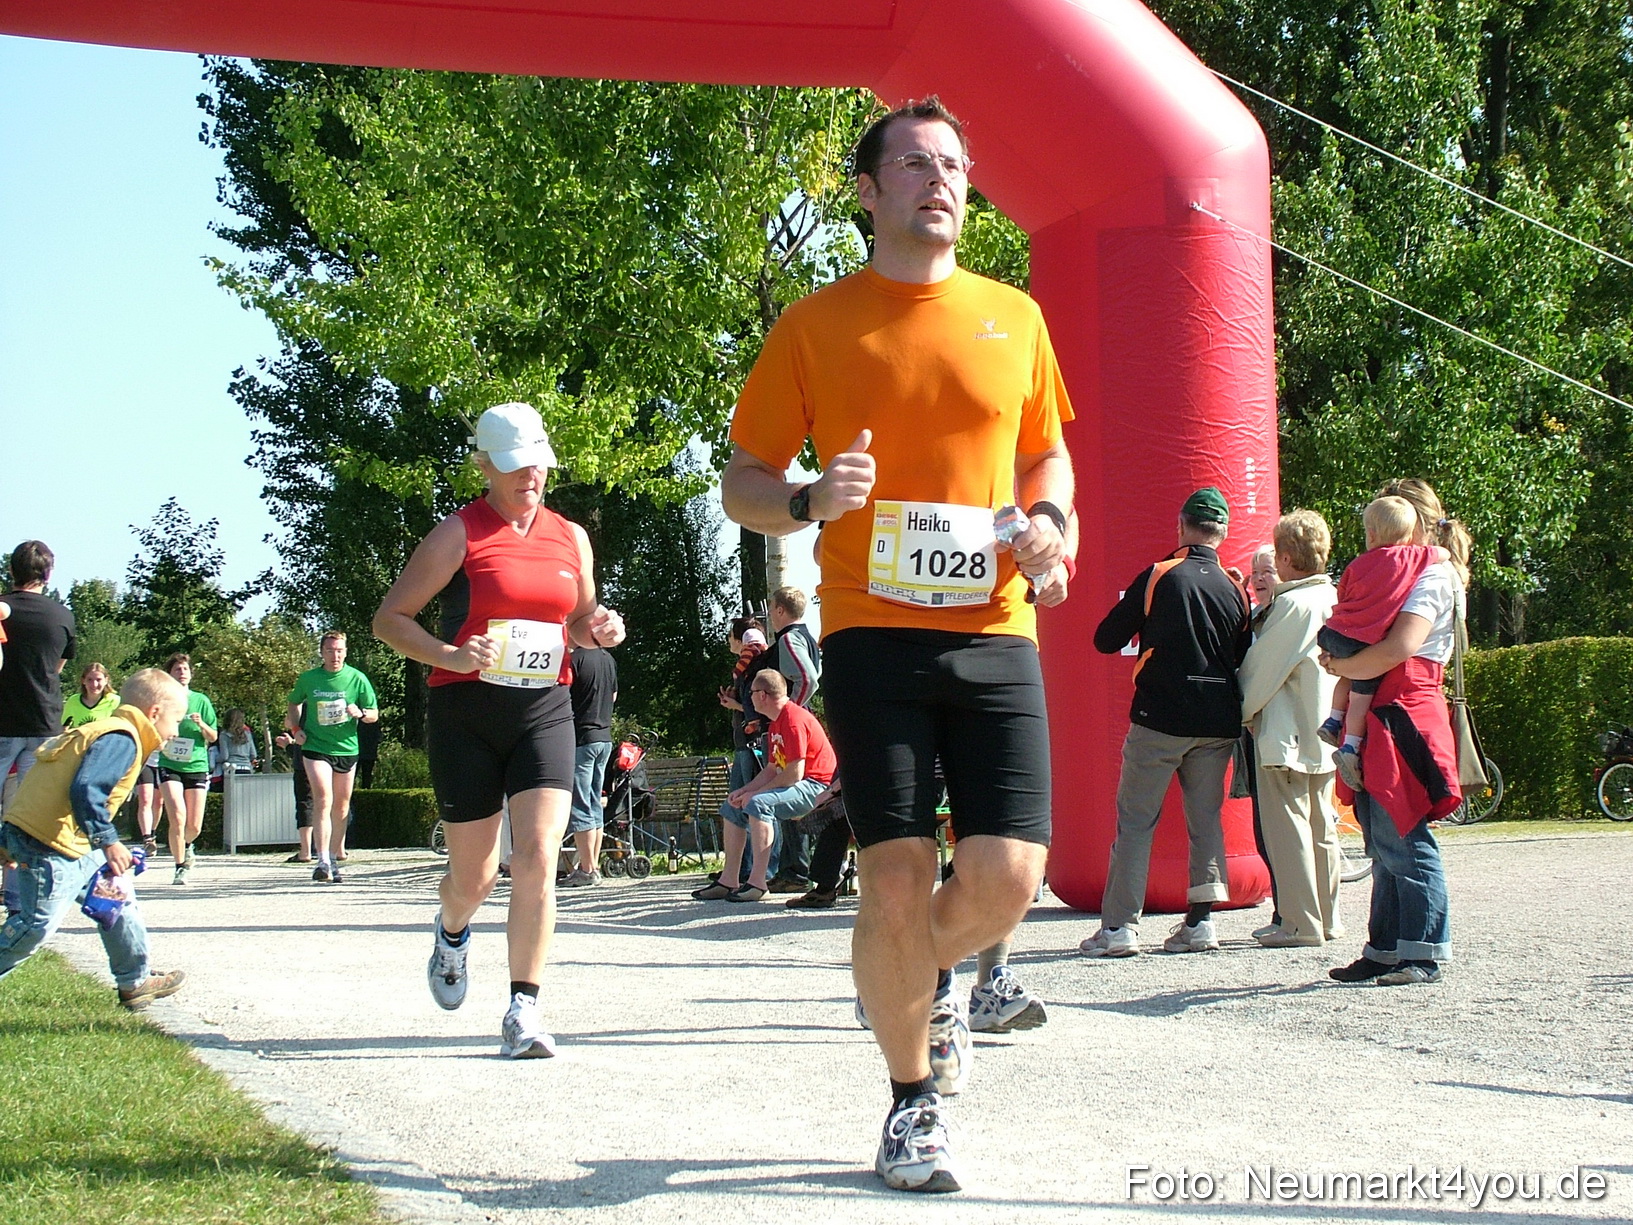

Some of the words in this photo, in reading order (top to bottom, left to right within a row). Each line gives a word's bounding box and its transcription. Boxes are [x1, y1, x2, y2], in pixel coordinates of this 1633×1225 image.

[907, 511, 951, 533] Heiko
[877, 540, 886, 553] D
[909, 548, 986, 580] 1028
[512, 626, 528, 639] Eva
[516, 650, 552, 670] 123
[313, 689, 347, 699] Sinupret
[328, 709, 343, 719] 358
[173, 747, 189, 756] 357
